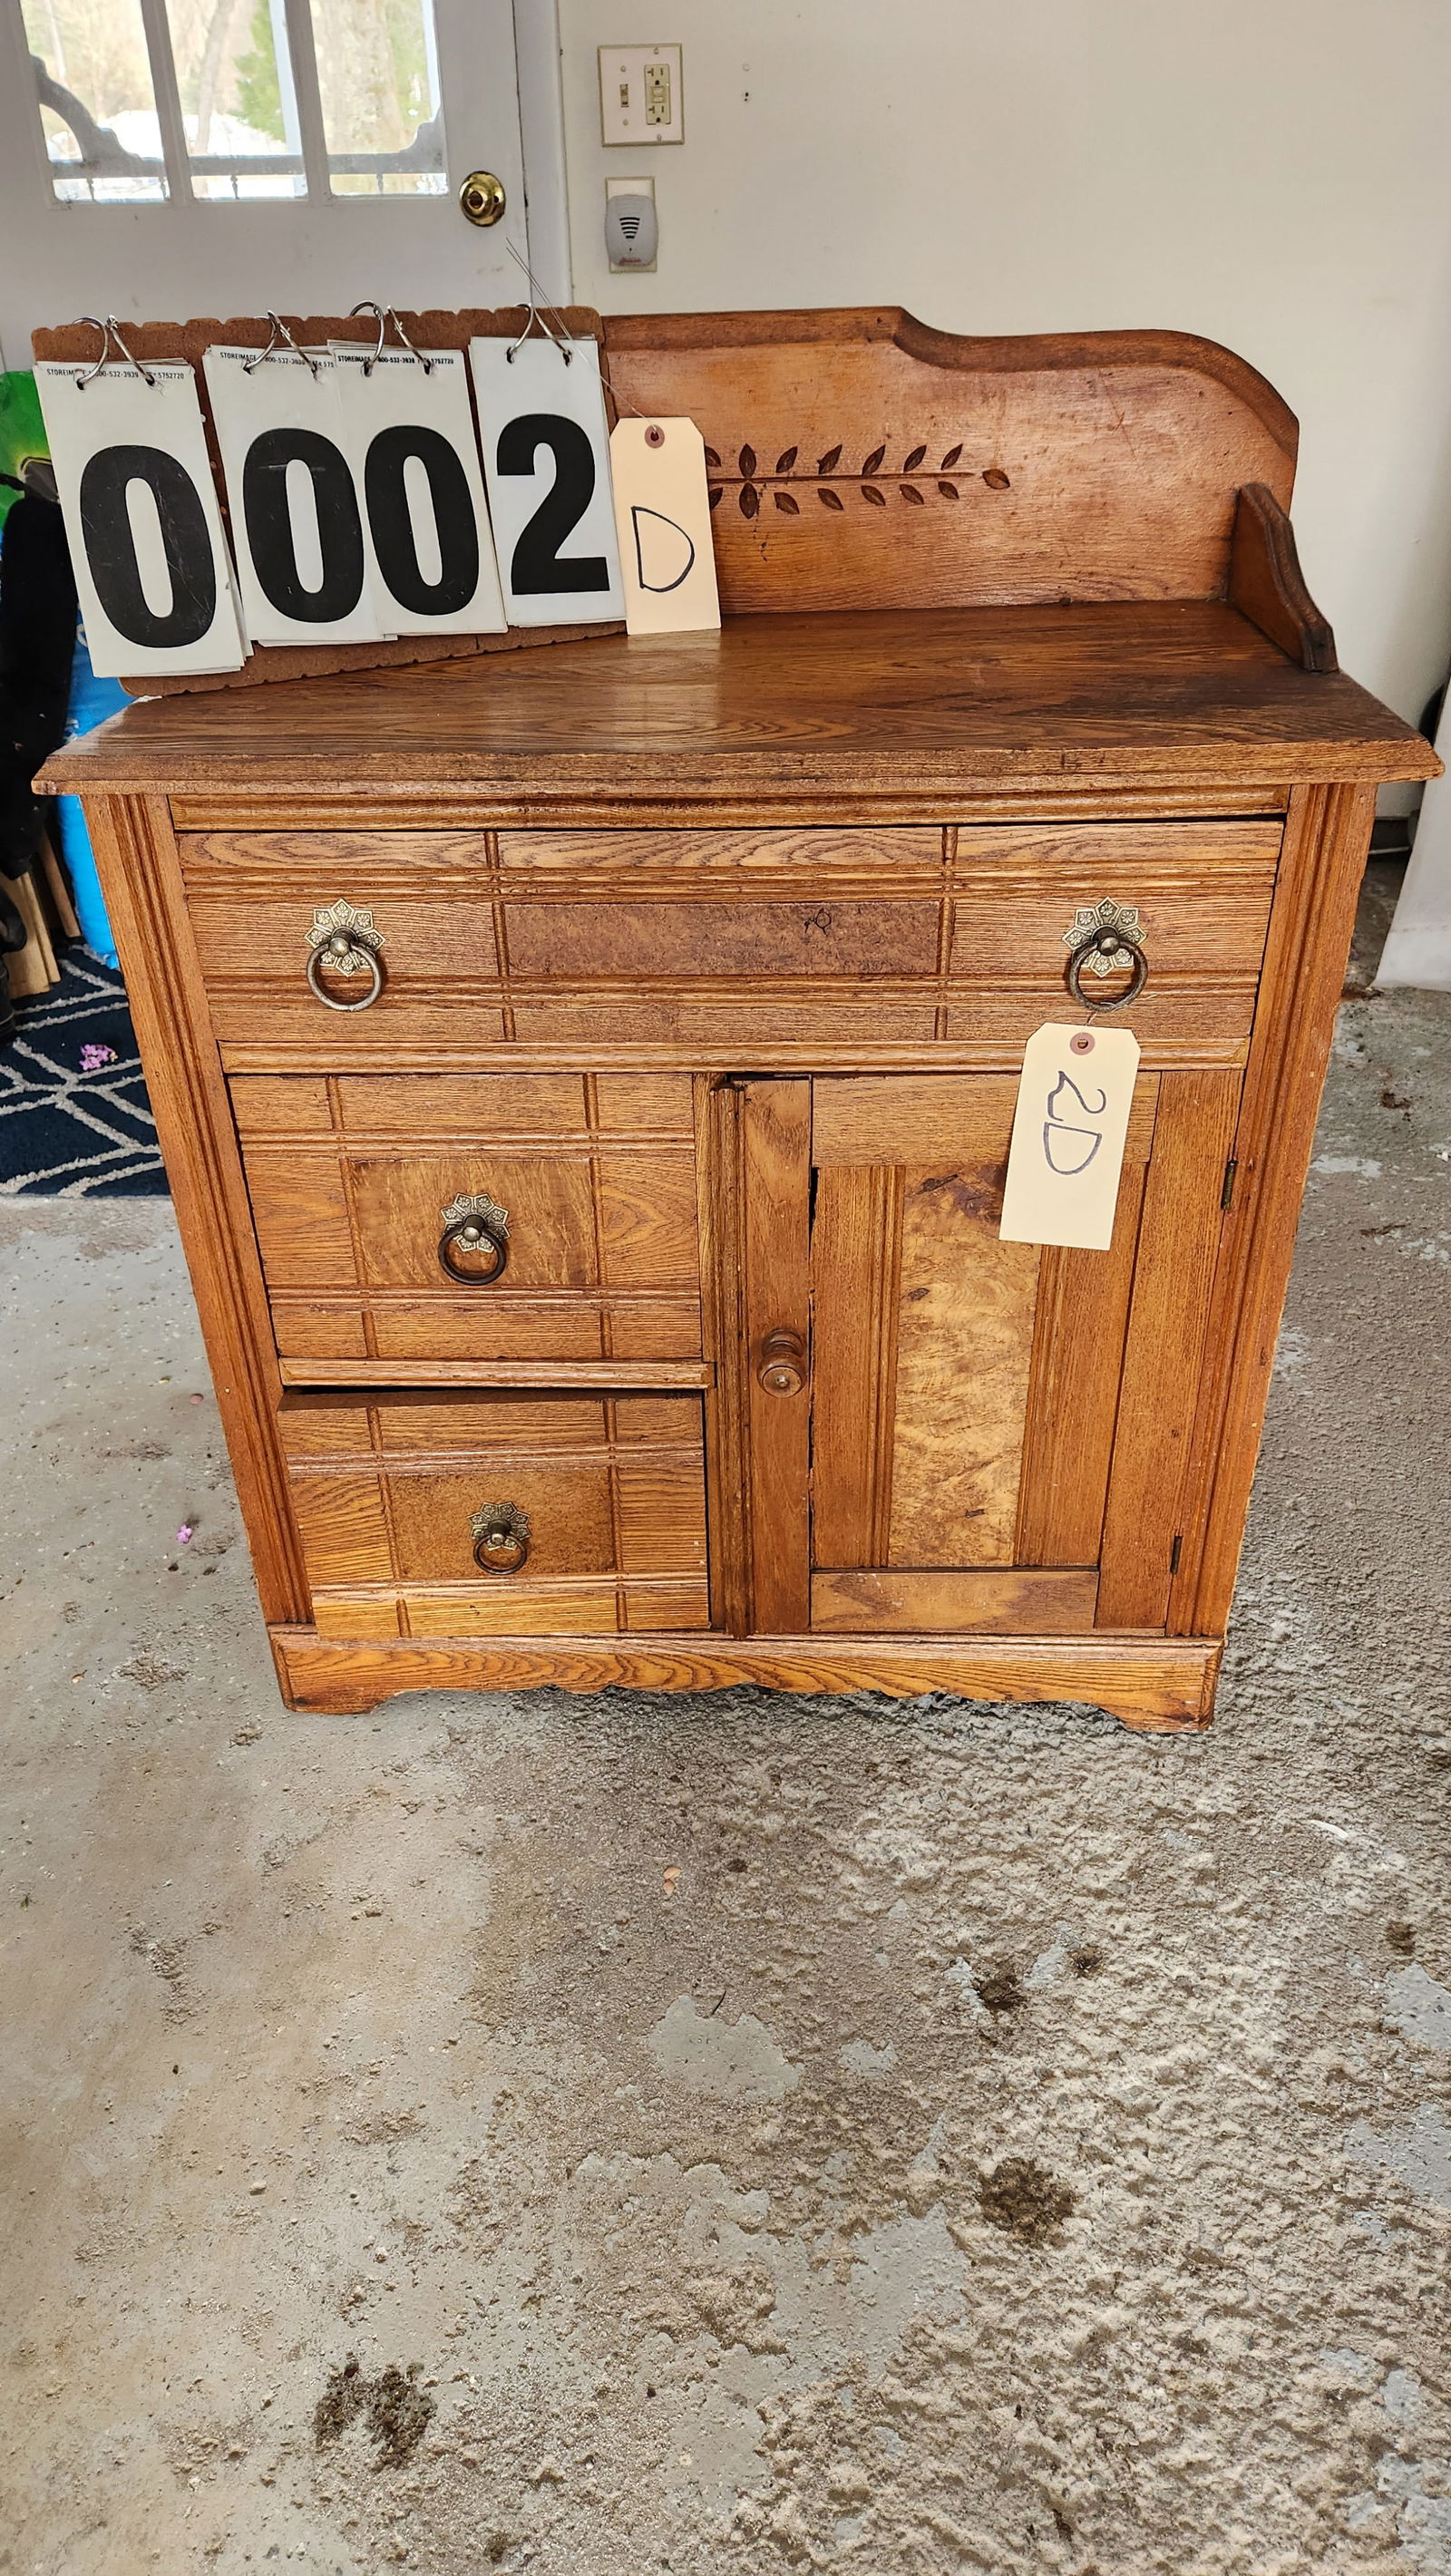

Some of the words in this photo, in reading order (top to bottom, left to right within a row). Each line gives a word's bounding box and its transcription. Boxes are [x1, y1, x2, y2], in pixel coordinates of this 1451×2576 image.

[46, 369, 86, 377] STOREIME
[631, 504, 696, 593] D
[1043, 1070, 1106, 1176] 2D
